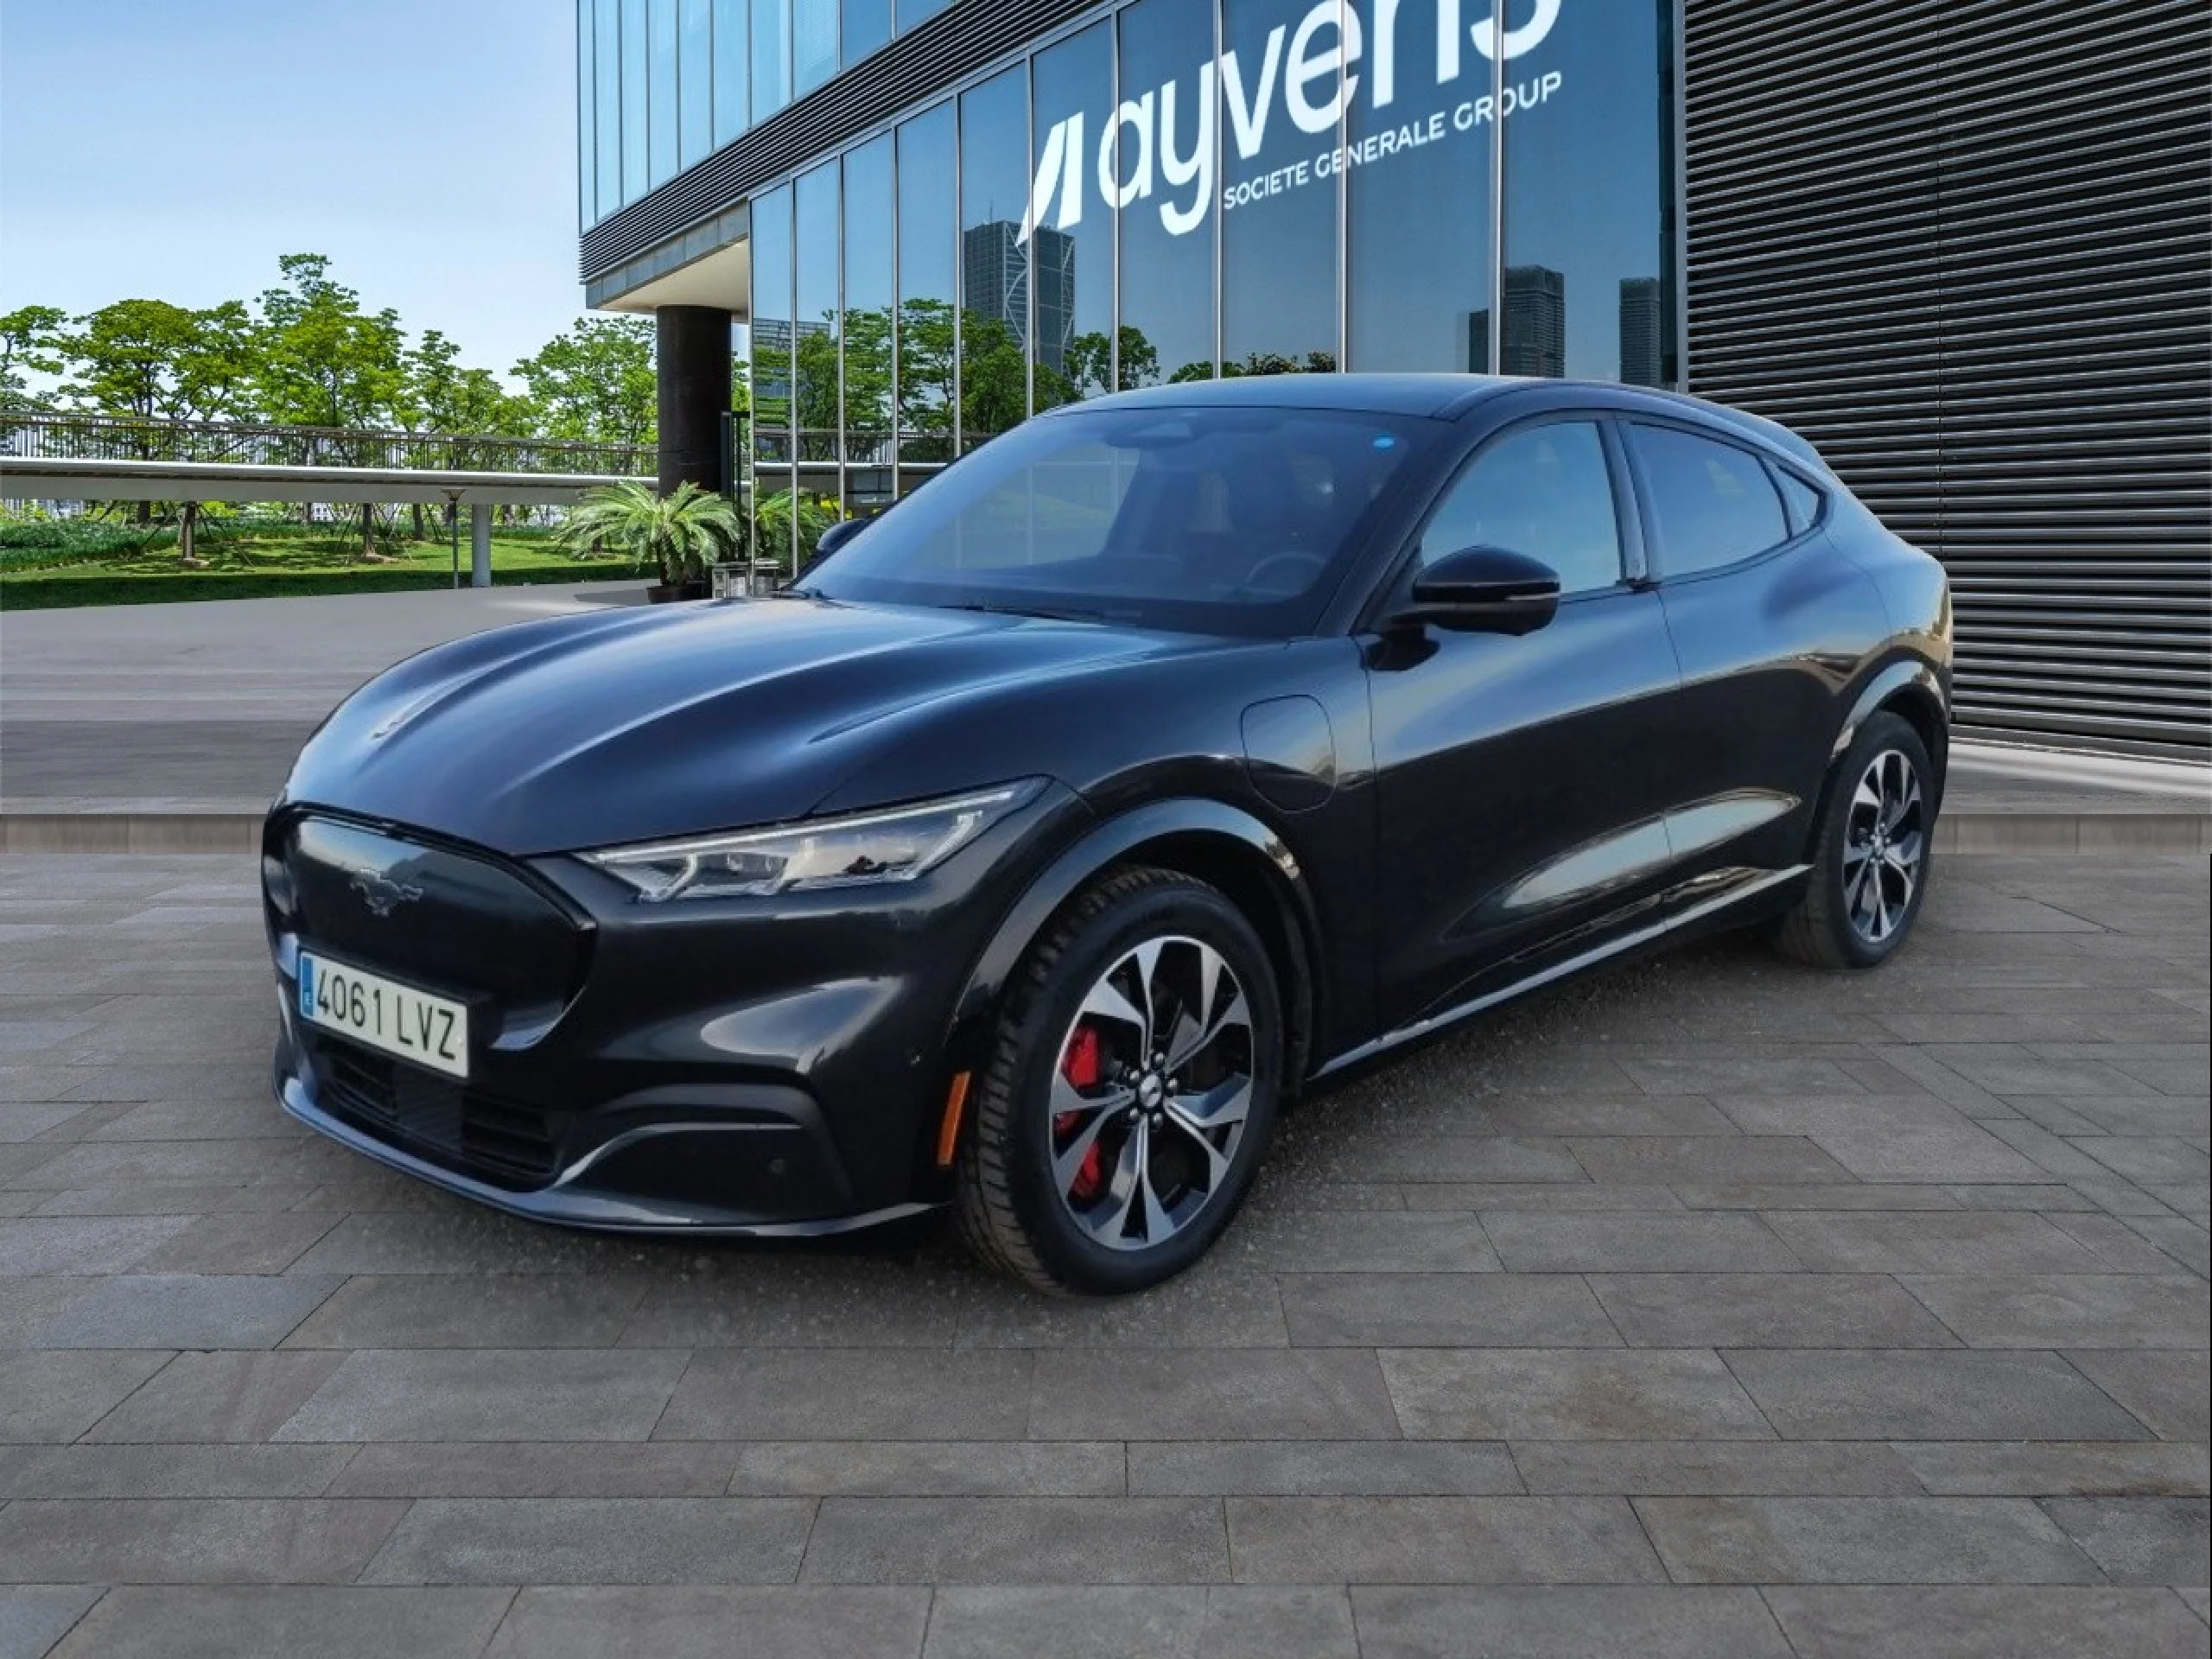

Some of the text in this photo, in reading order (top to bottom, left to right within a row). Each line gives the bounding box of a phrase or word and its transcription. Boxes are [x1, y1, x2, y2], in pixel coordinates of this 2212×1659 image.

[1223, 70, 1562, 210] SOCIETE GENERALE GROUP
[317, 969, 456, 1061] 4061 LVZ
